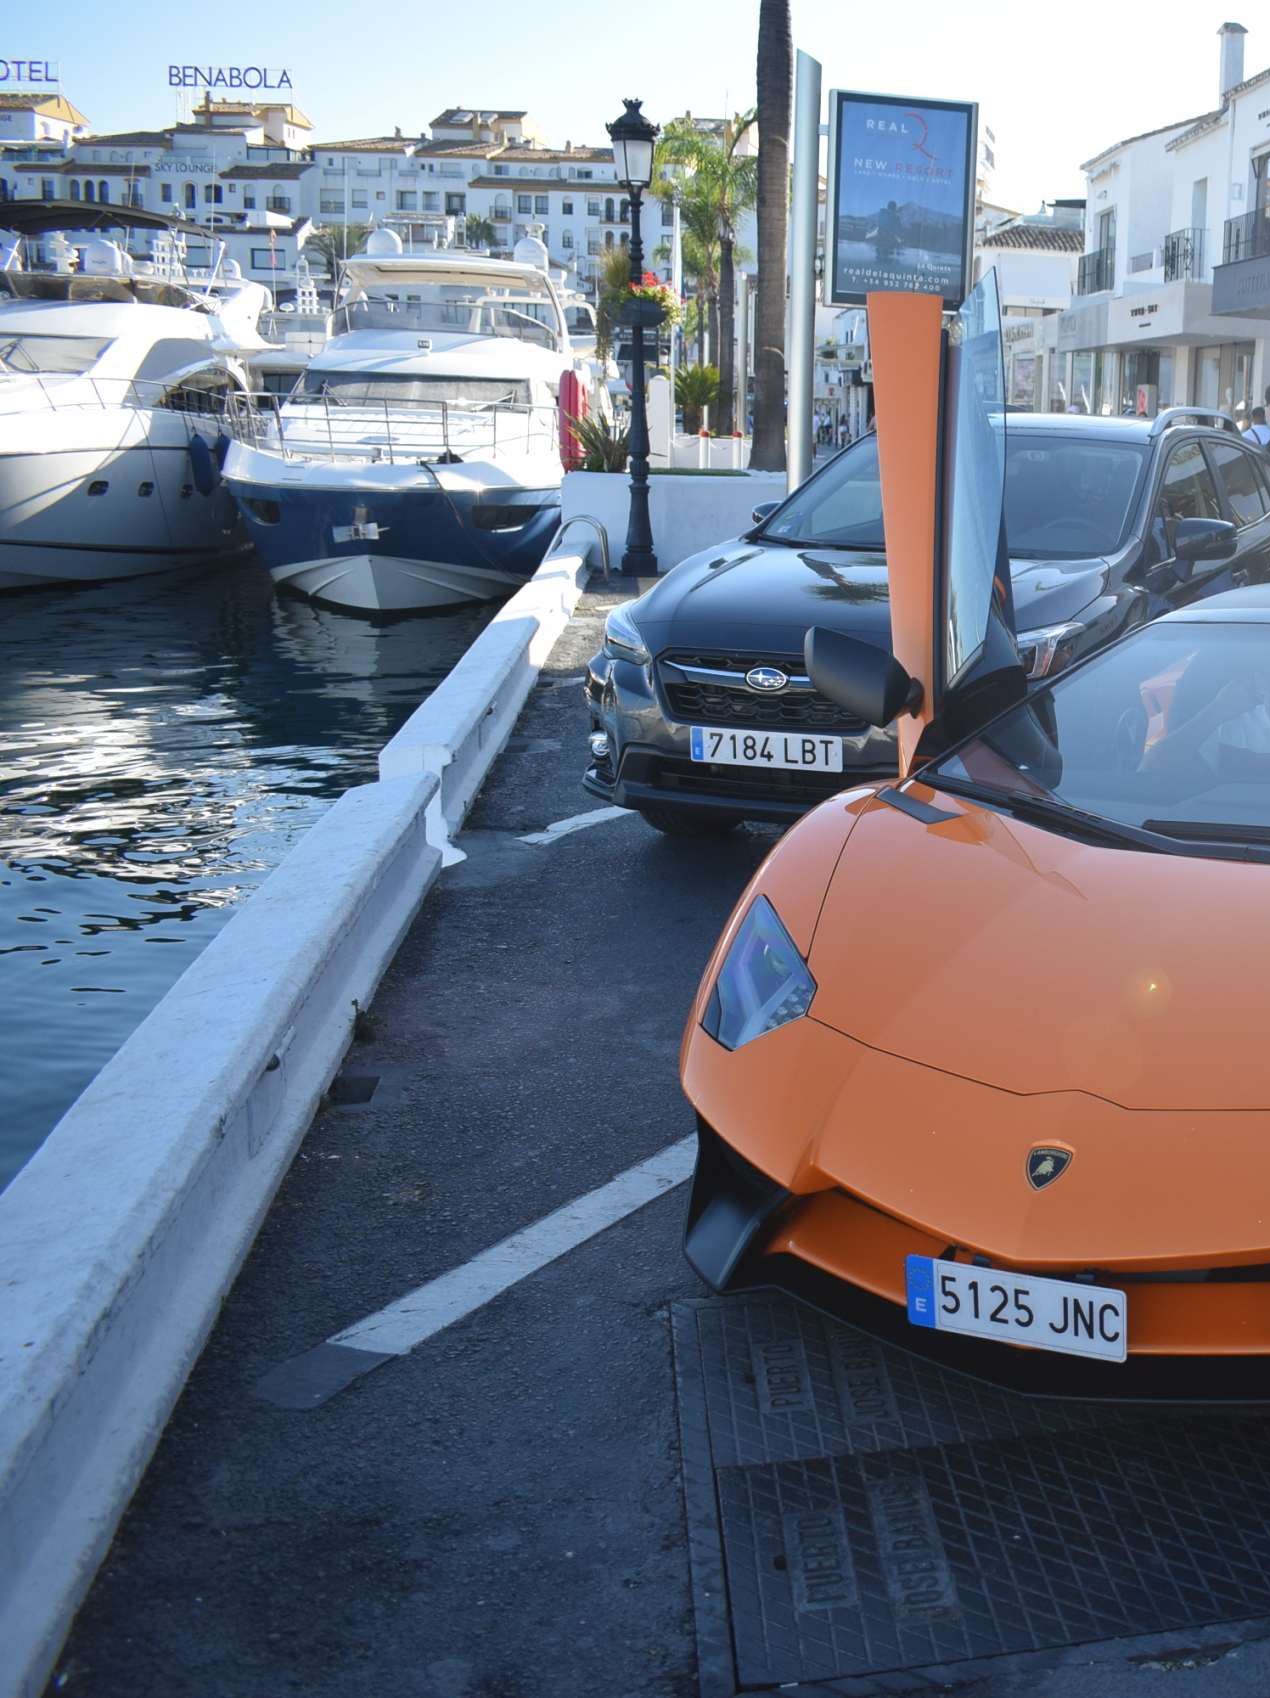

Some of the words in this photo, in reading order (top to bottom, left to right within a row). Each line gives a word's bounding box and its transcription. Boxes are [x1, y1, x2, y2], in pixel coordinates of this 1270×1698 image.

[168, 65, 293, 89] BENABOLA
[866, 119, 909, 133] REAL
[155, 162, 174, 172] SKY
[175, 163, 216, 174] LOUNGE
[854, 158, 888, 170] NEW
[895, 163, 953, 178] RESORT
[843, 267, 949, 284] realdelaquinta.com
[863, 277, 879, 285] +34
[883, 279, 899, 287] 952
[923, 284, 941, 292] 400
[708, 732, 774, 762] 7184
[784, 738, 834, 766] LBT
[915, 1297, 927, 1313] E
[940, 1275, 1034, 1328] 5125
[1049, 1296, 1120, 1343] JNC
[762, 1343, 803, 1412] PUERTO
[847, 1377, 888, 1419] JOSE
[797, 1513, 847, 1604] PUERTO
[898, 1561, 947, 1618] JOSE
